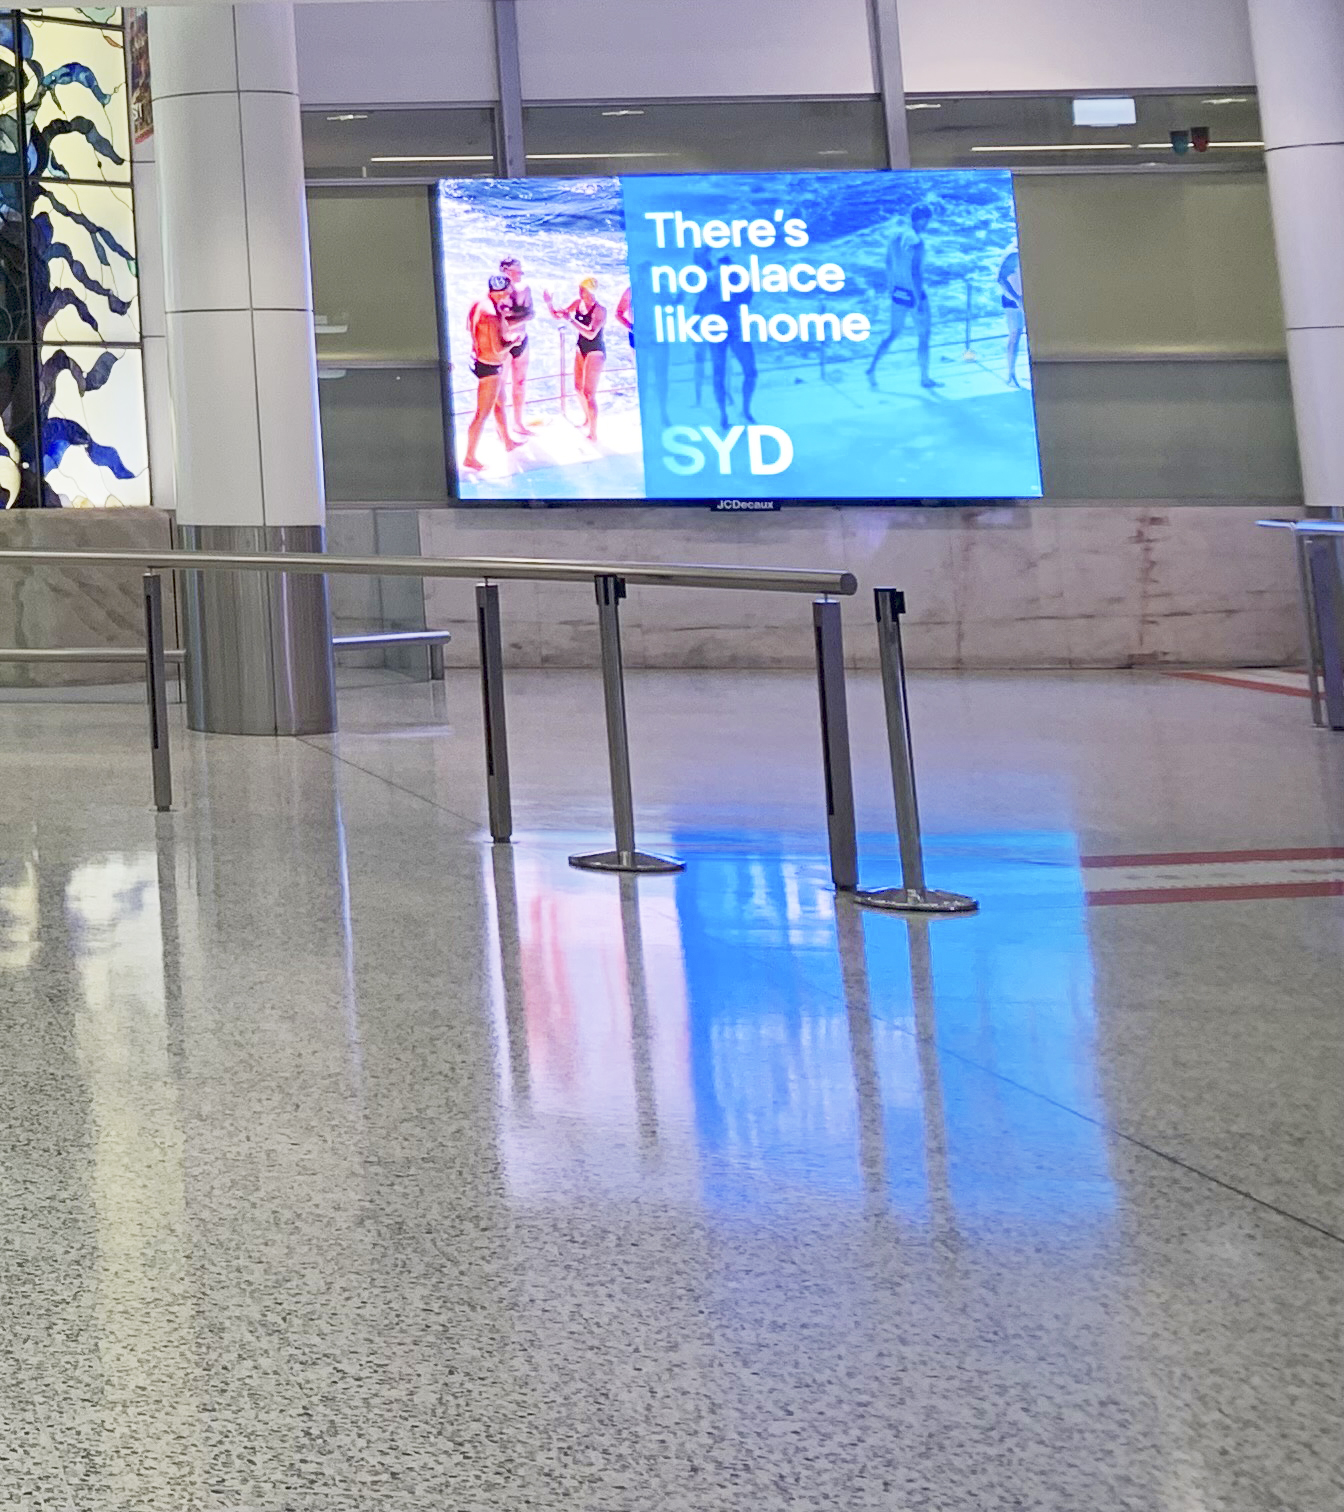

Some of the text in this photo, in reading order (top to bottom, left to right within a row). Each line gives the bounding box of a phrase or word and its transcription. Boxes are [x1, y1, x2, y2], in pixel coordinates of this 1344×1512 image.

[645, 208, 808, 250] There's
[652, 254, 845, 301] no place
[654, 304, 871, 344] like home
[661, 424, 794, 476] SYD
[717, 499, 774, 510] JCDecaux
